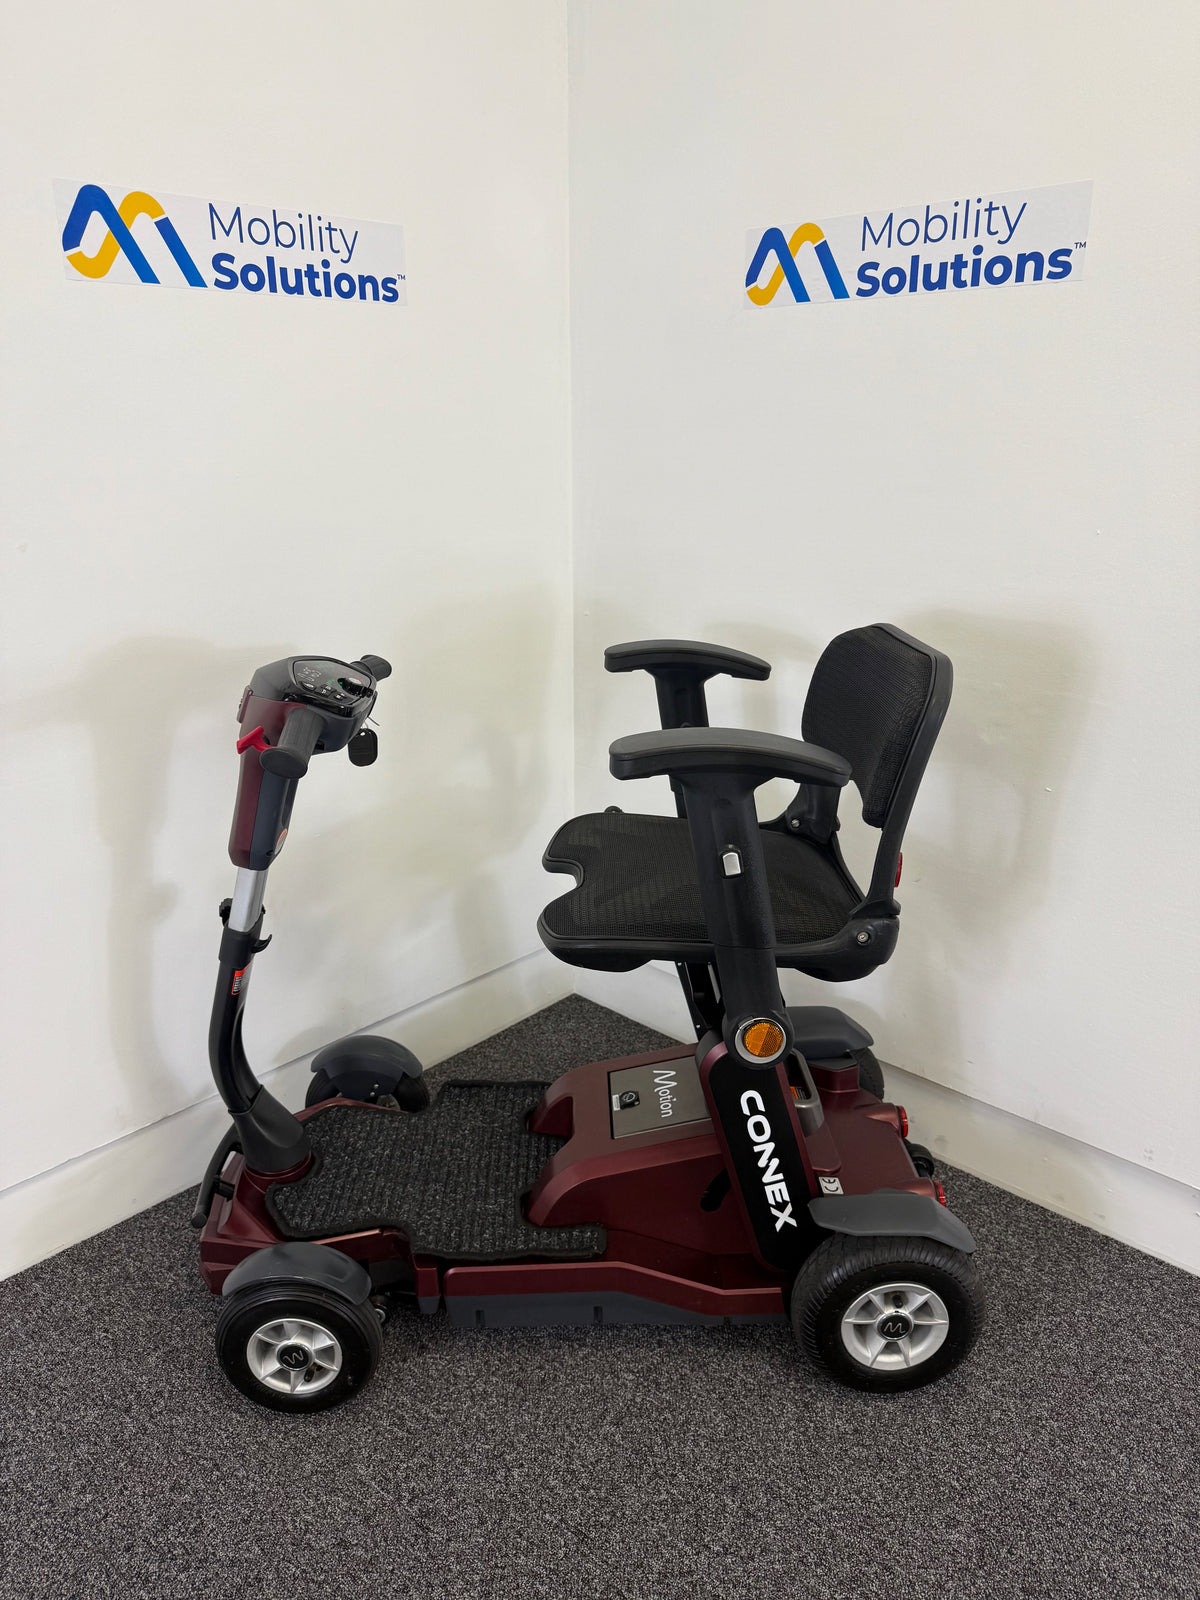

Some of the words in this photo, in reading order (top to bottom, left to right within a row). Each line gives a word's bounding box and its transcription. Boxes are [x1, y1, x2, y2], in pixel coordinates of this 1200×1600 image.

[208, 202, 359, 264] Mobility
[862, 197, 1027, 252] Mobility
[652, 1069, 678, 1118] Motion
[740, 1089, 798, 1232] CONNEX
